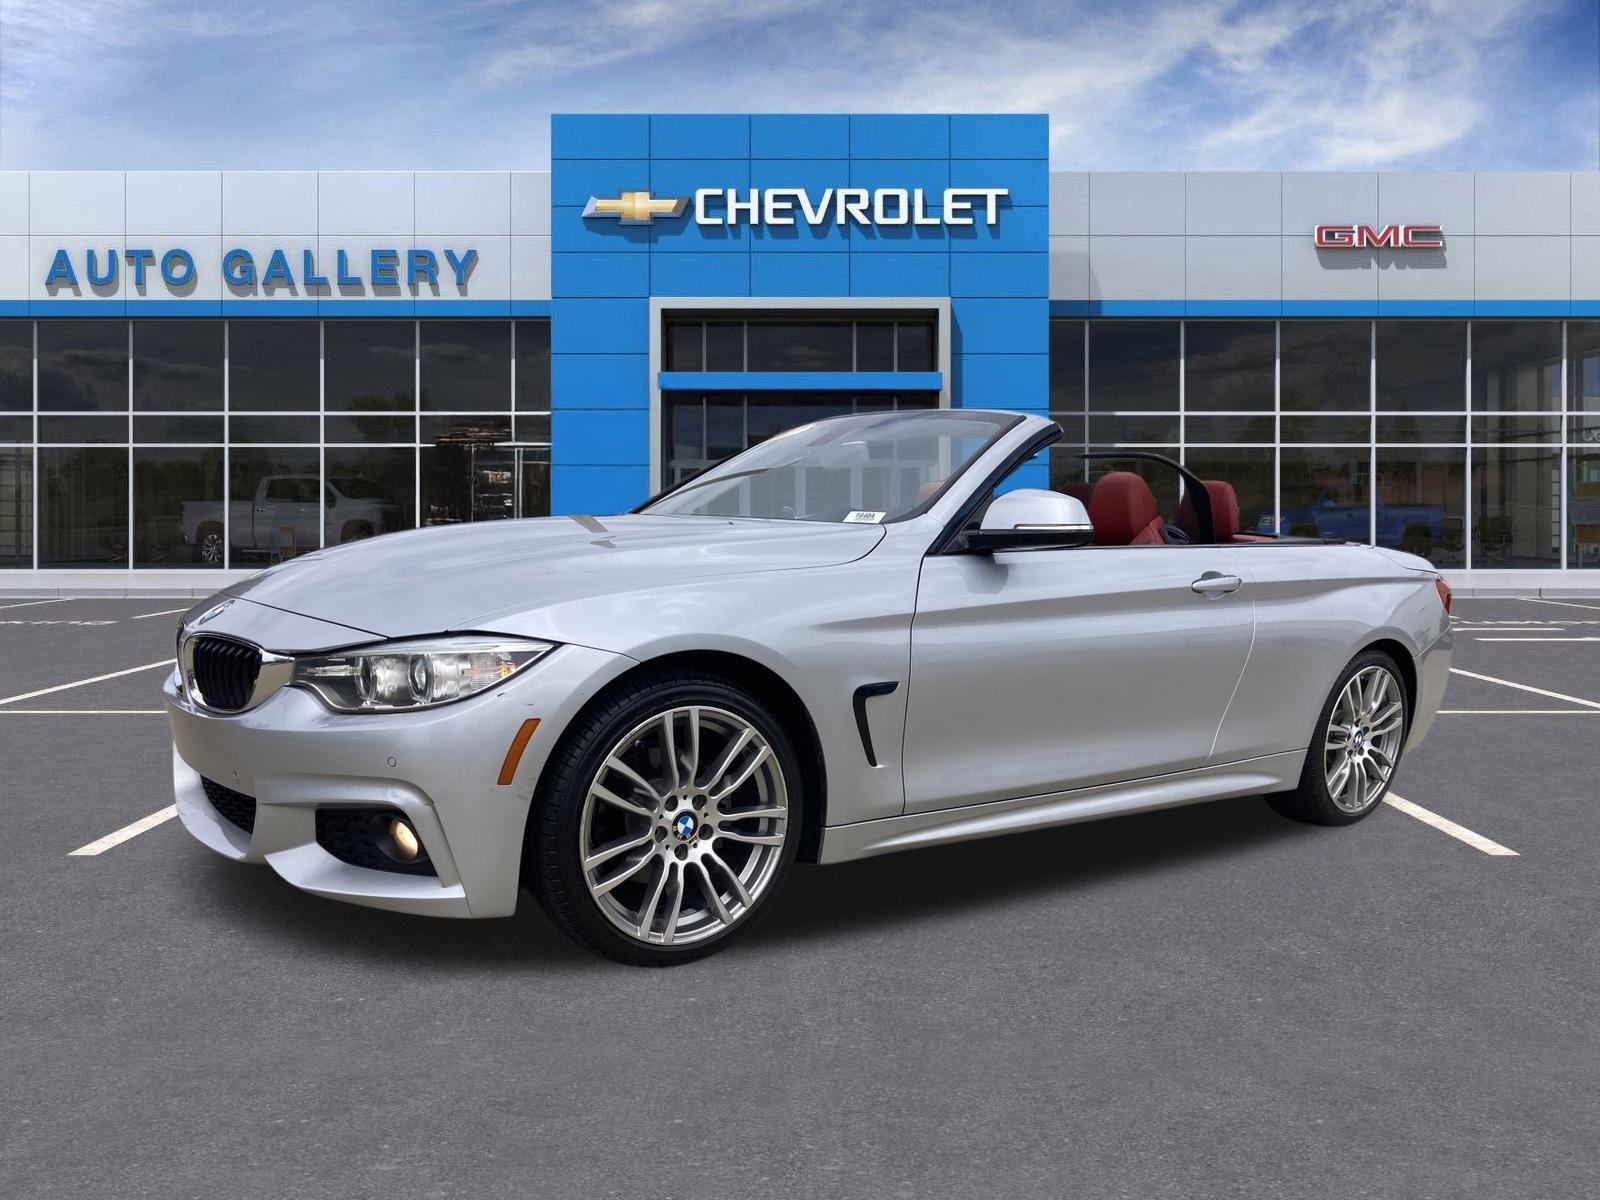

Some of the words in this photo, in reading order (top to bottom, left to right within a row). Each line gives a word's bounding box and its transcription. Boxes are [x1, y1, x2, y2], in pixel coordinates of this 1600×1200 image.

[695, 188, 1008, 224] CHEVROLET
[1314, 224, 1443, 248] GMC
[45, 248, 195, 286] AUTO
[222, 248, 477, 286] GALLERY
